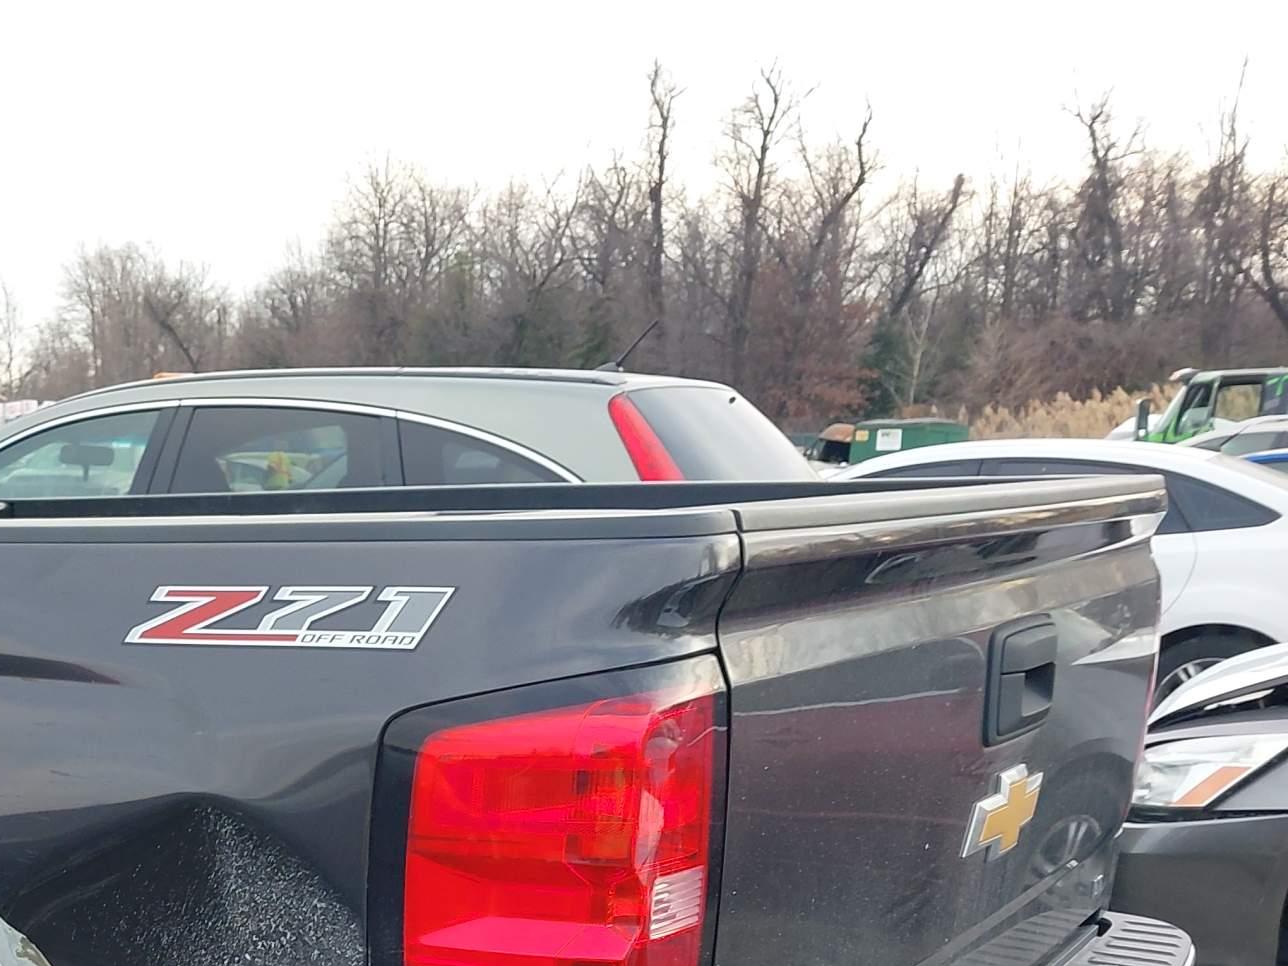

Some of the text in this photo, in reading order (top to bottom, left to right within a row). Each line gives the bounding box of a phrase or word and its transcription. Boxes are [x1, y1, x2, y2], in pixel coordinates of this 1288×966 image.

[124, 585, 457, 650] Z71
[300, 633, 416, 647] OFF ROAD
